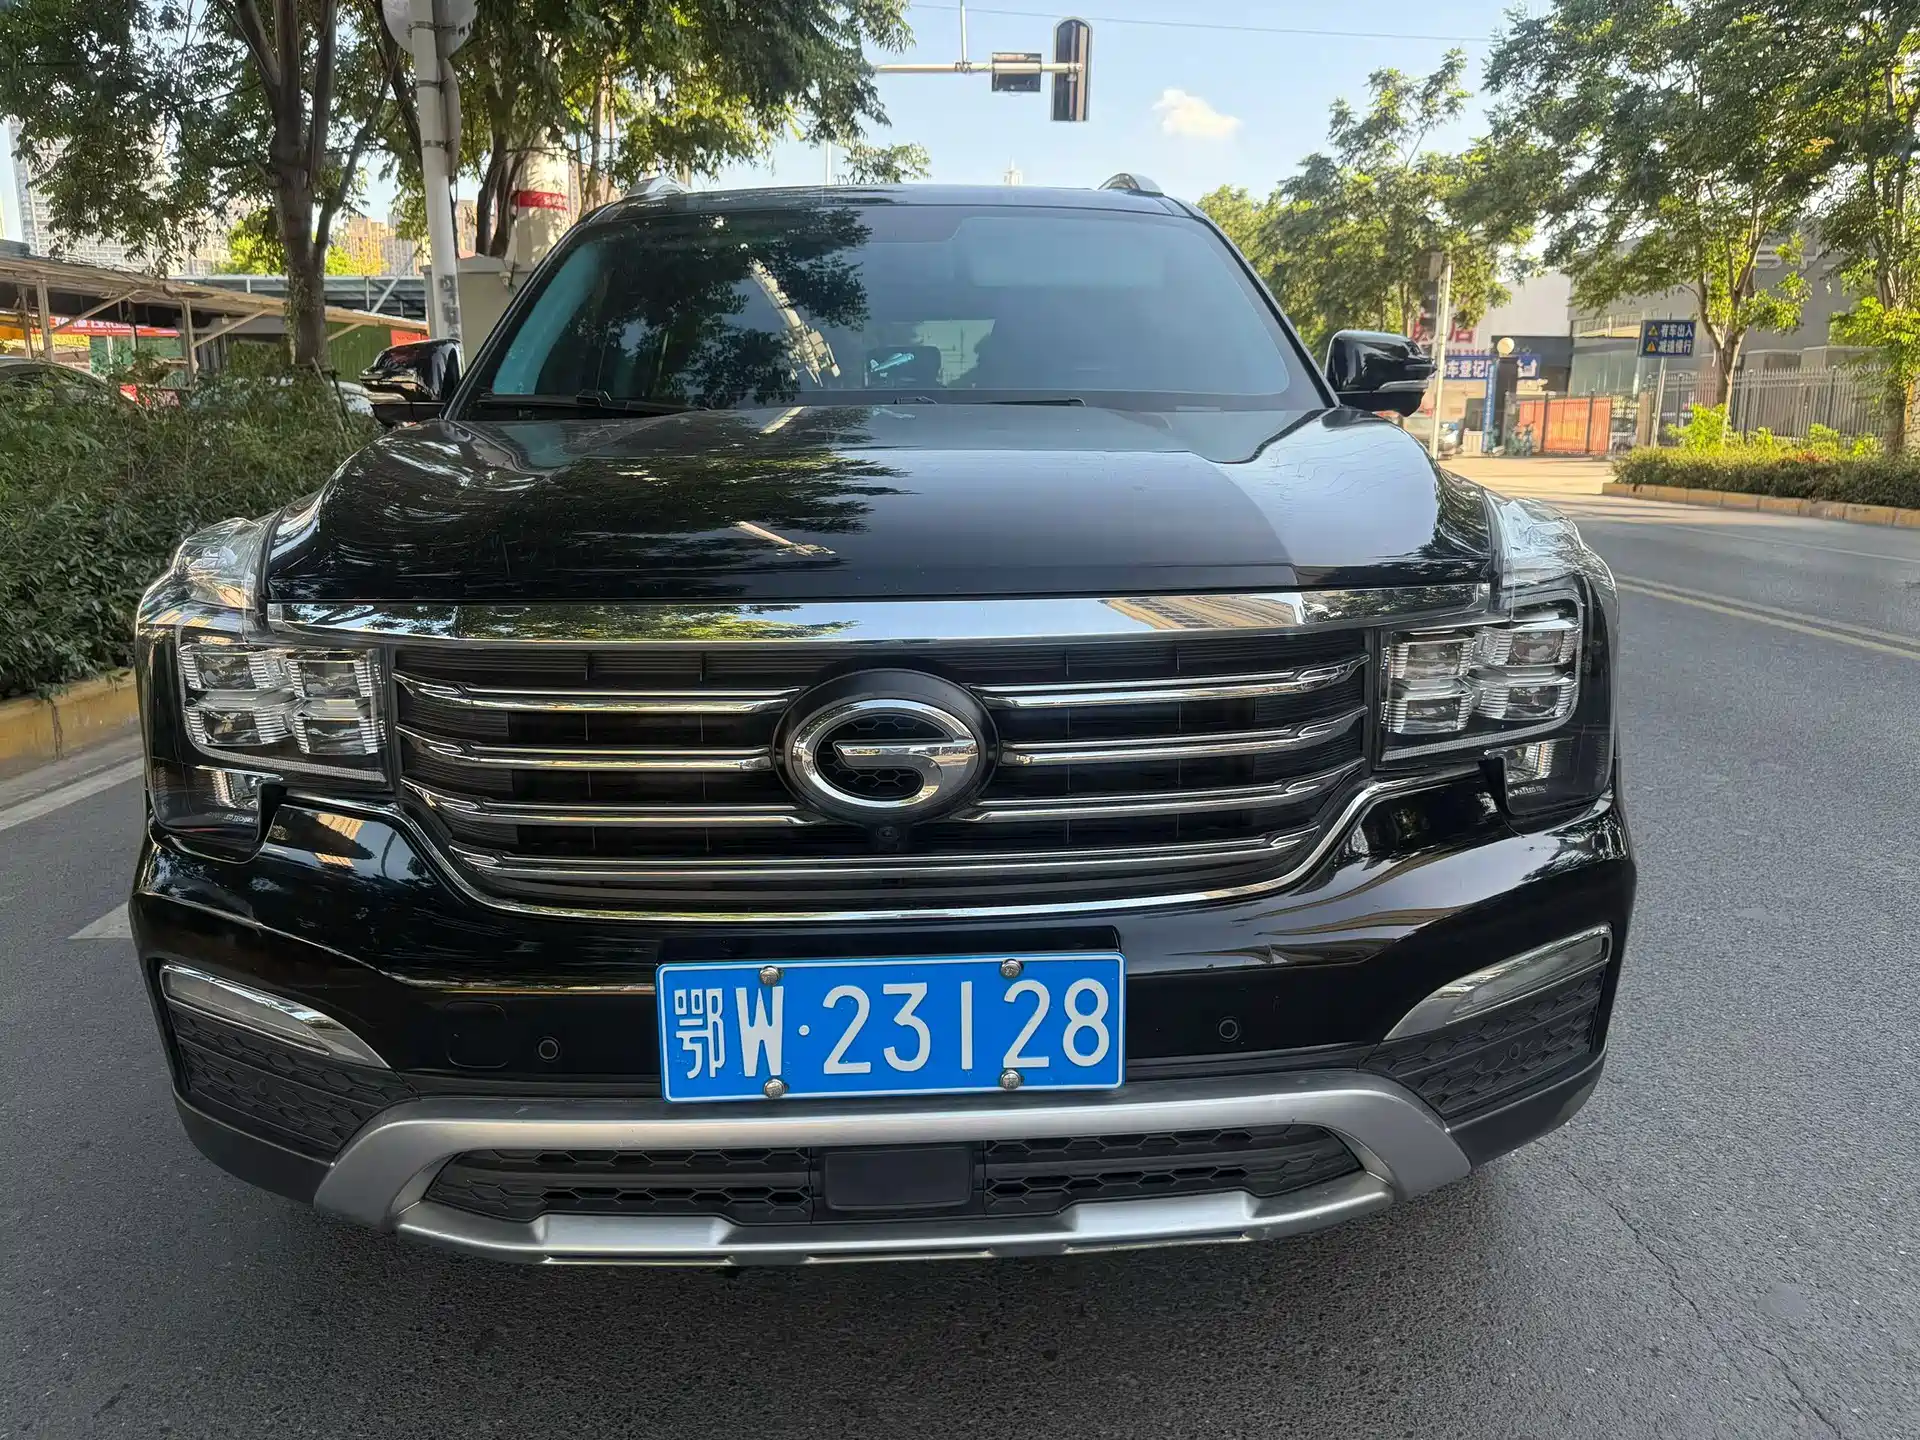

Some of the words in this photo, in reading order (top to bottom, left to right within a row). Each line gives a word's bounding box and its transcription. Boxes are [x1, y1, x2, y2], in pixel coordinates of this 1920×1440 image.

[1660, 323, 1693, 337] 有车出入
[1658, 339, 1691, 353] 减速慢行
